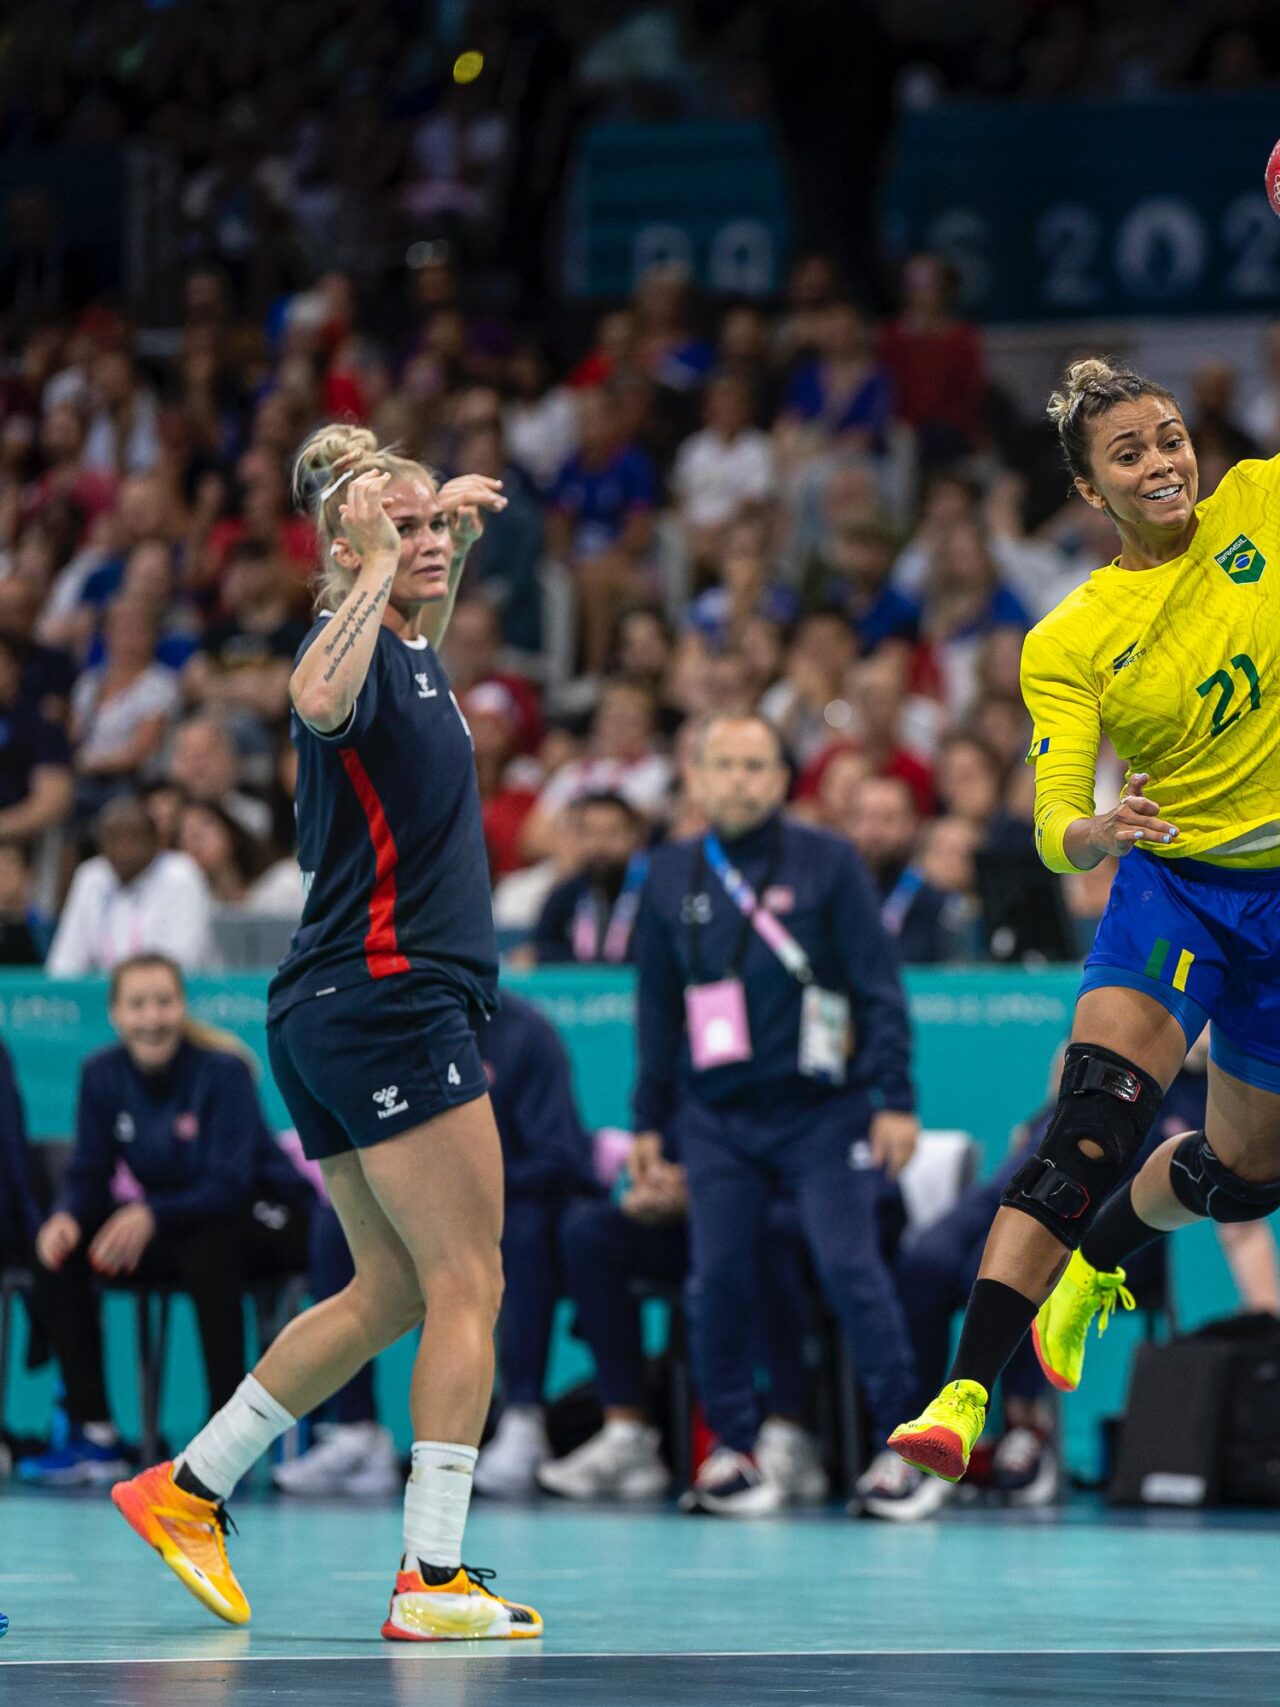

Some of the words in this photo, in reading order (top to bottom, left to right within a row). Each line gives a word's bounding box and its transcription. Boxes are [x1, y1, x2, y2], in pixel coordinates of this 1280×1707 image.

[1217, 538, 1248, 564] BRASIL
[1196, 653, 1261, 737] 21
[447, 1062, 461, 1086] 4
